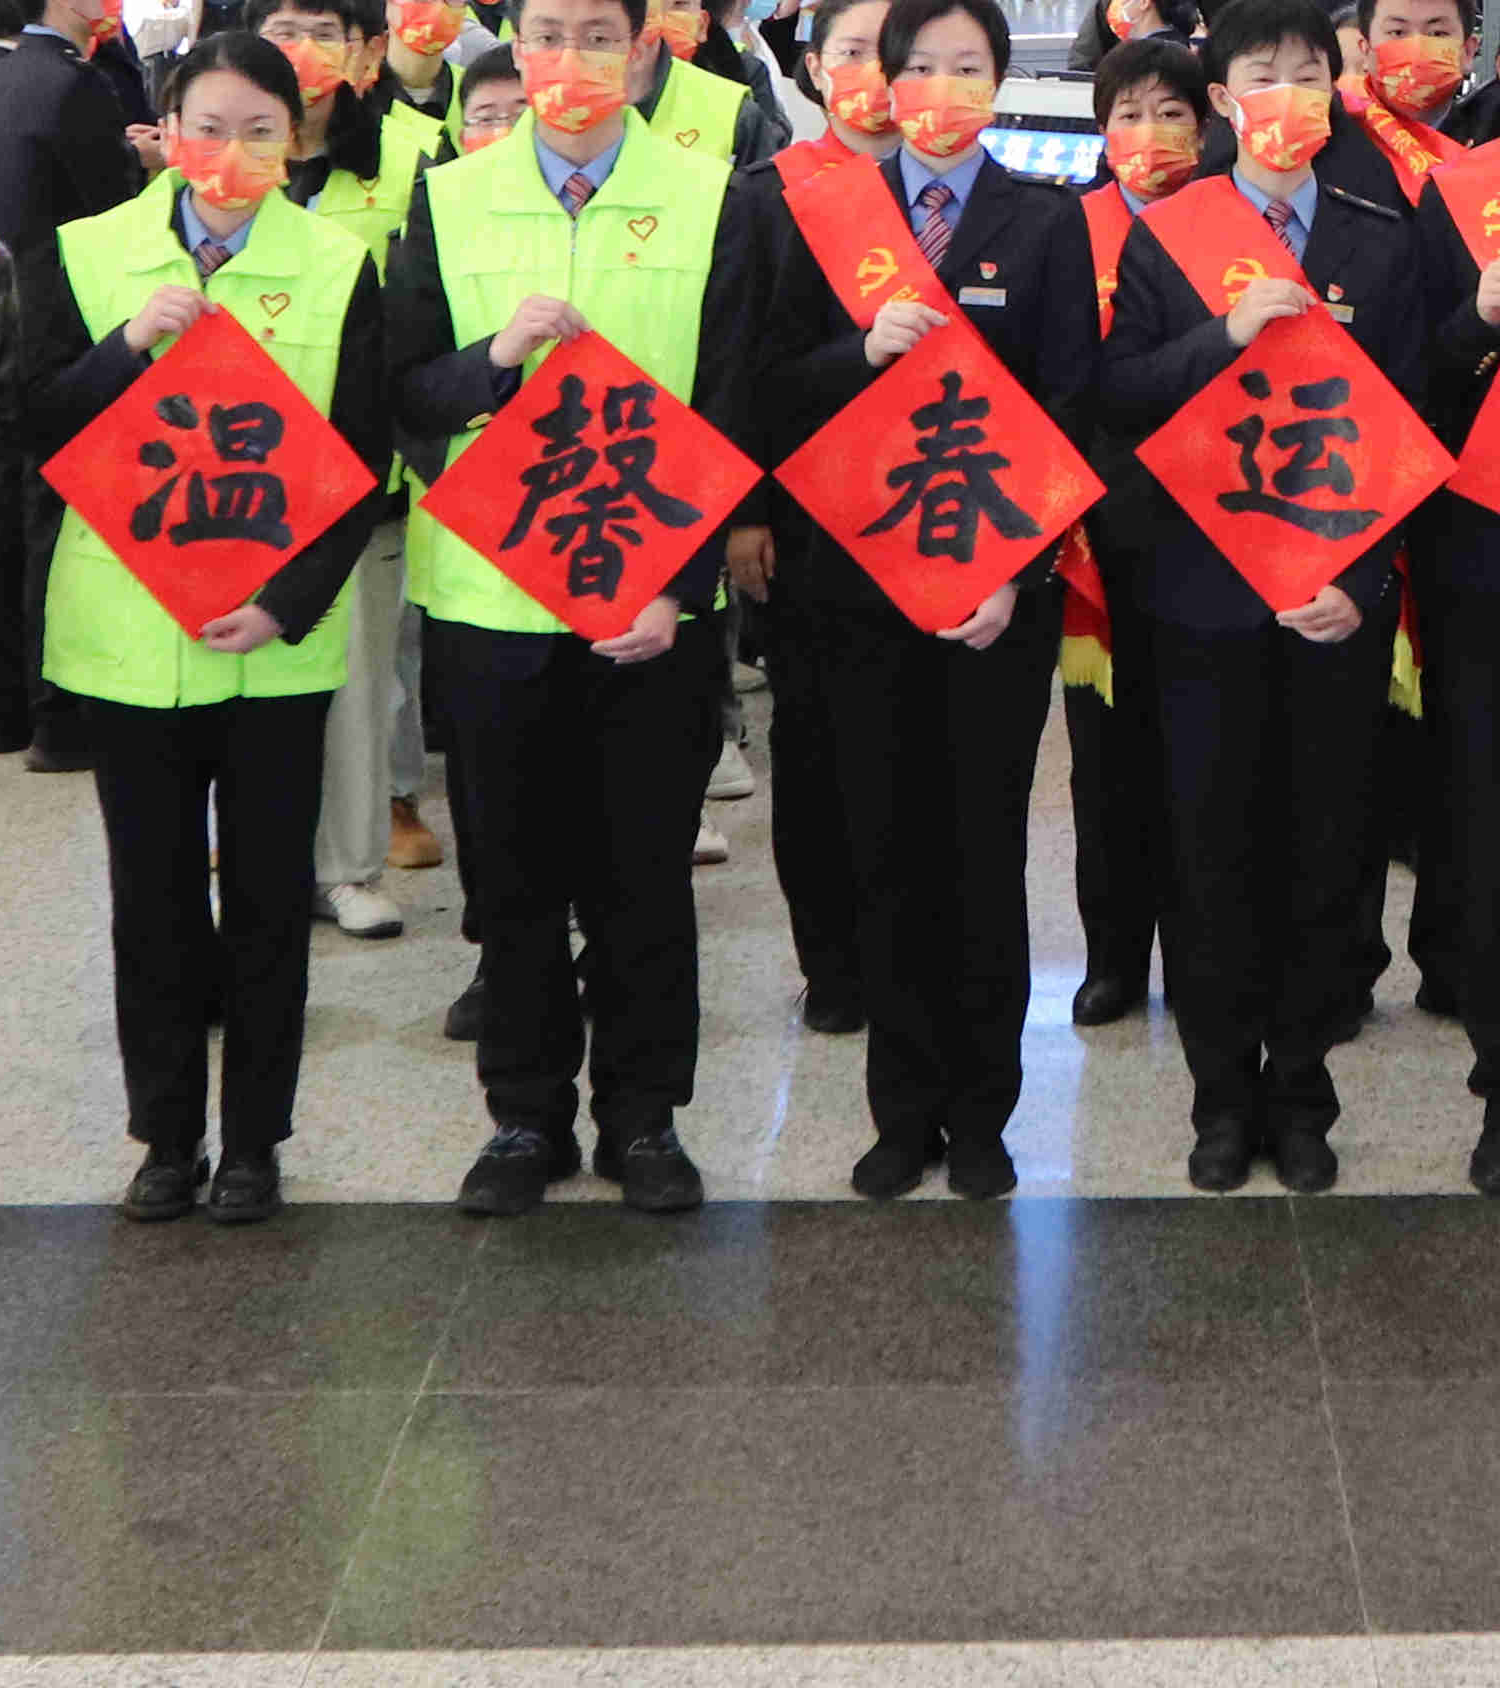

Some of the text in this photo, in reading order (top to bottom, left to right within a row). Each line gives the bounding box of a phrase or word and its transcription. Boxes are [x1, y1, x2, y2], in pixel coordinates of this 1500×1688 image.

[129, 393, 293, 551] 温
[500, 374, 703, 602] 馨
[857, 371, 1043, 564] 春
[1216, 371, 1385, 541] 运
